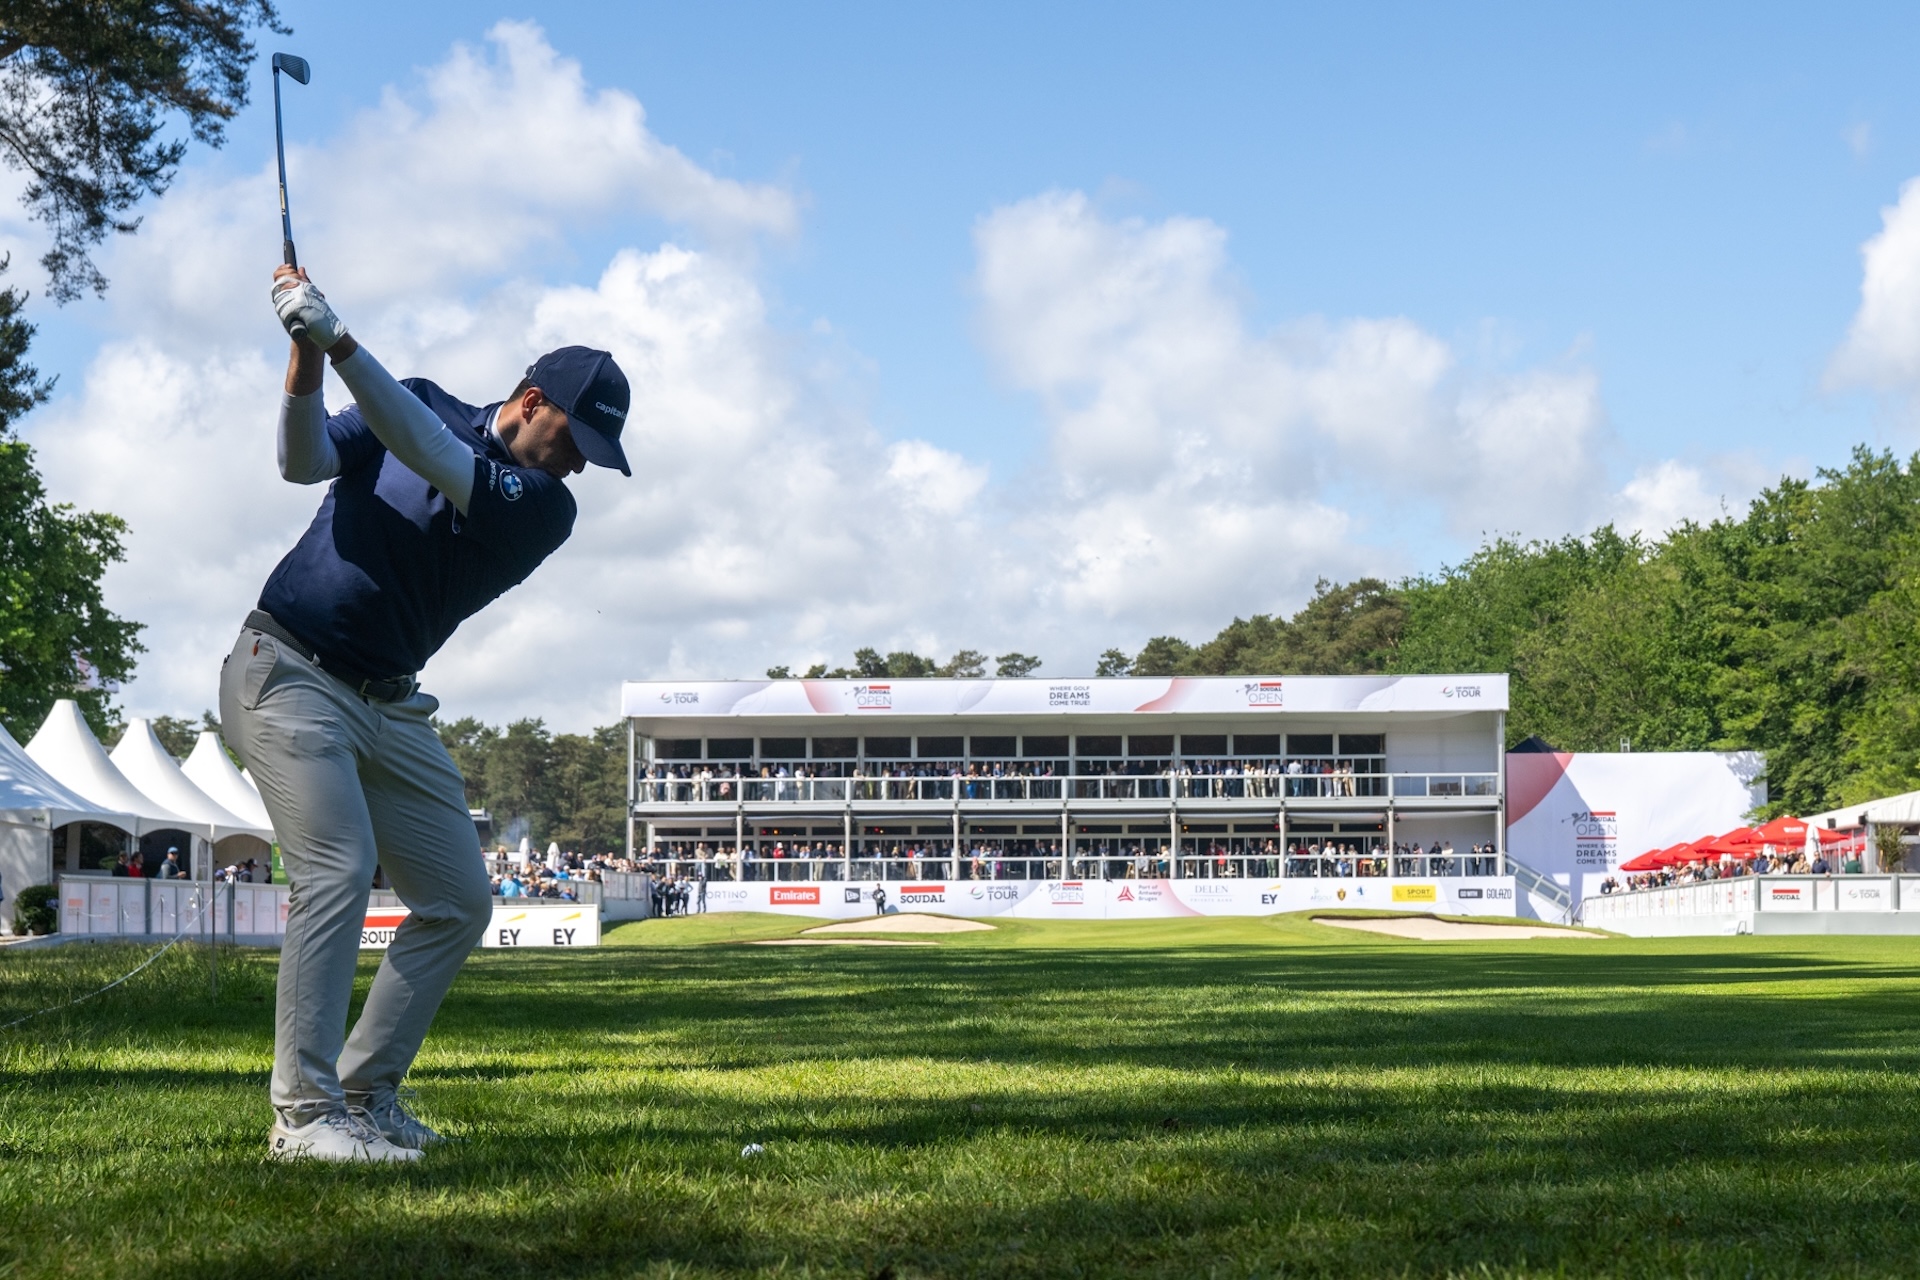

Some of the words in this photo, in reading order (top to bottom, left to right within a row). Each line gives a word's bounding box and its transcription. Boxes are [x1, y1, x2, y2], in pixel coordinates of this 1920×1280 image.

[1049, 692, 1090, 700] DREAMS
[1248, 692, 1283, 703] OPEN
[1456, 689, 1481, 699] TOUR
[674, 696, 699, 704] TOUR
[857, 695, 892, 706] OPEN
[1576, 823, 1618, 836] OPEN
[706, 890, 748, 899] ORTINO
[1194, 884, 1229, 894] DELEN
[1486, 888, 1512, 899] GOLAZO
[773, 890, 817, 901] Emirates
[900, 894, 945, 904] SOUDAL
[987, 890, 1019, 901] TOUR
[1051, 891, 1084, 901] OPEN
[1261, 894, 1278, 904] EY
[361, 930, 397, 944] SOUD
[499, 929, 521, 945] EY
[553, 928, 576, 945] EY
